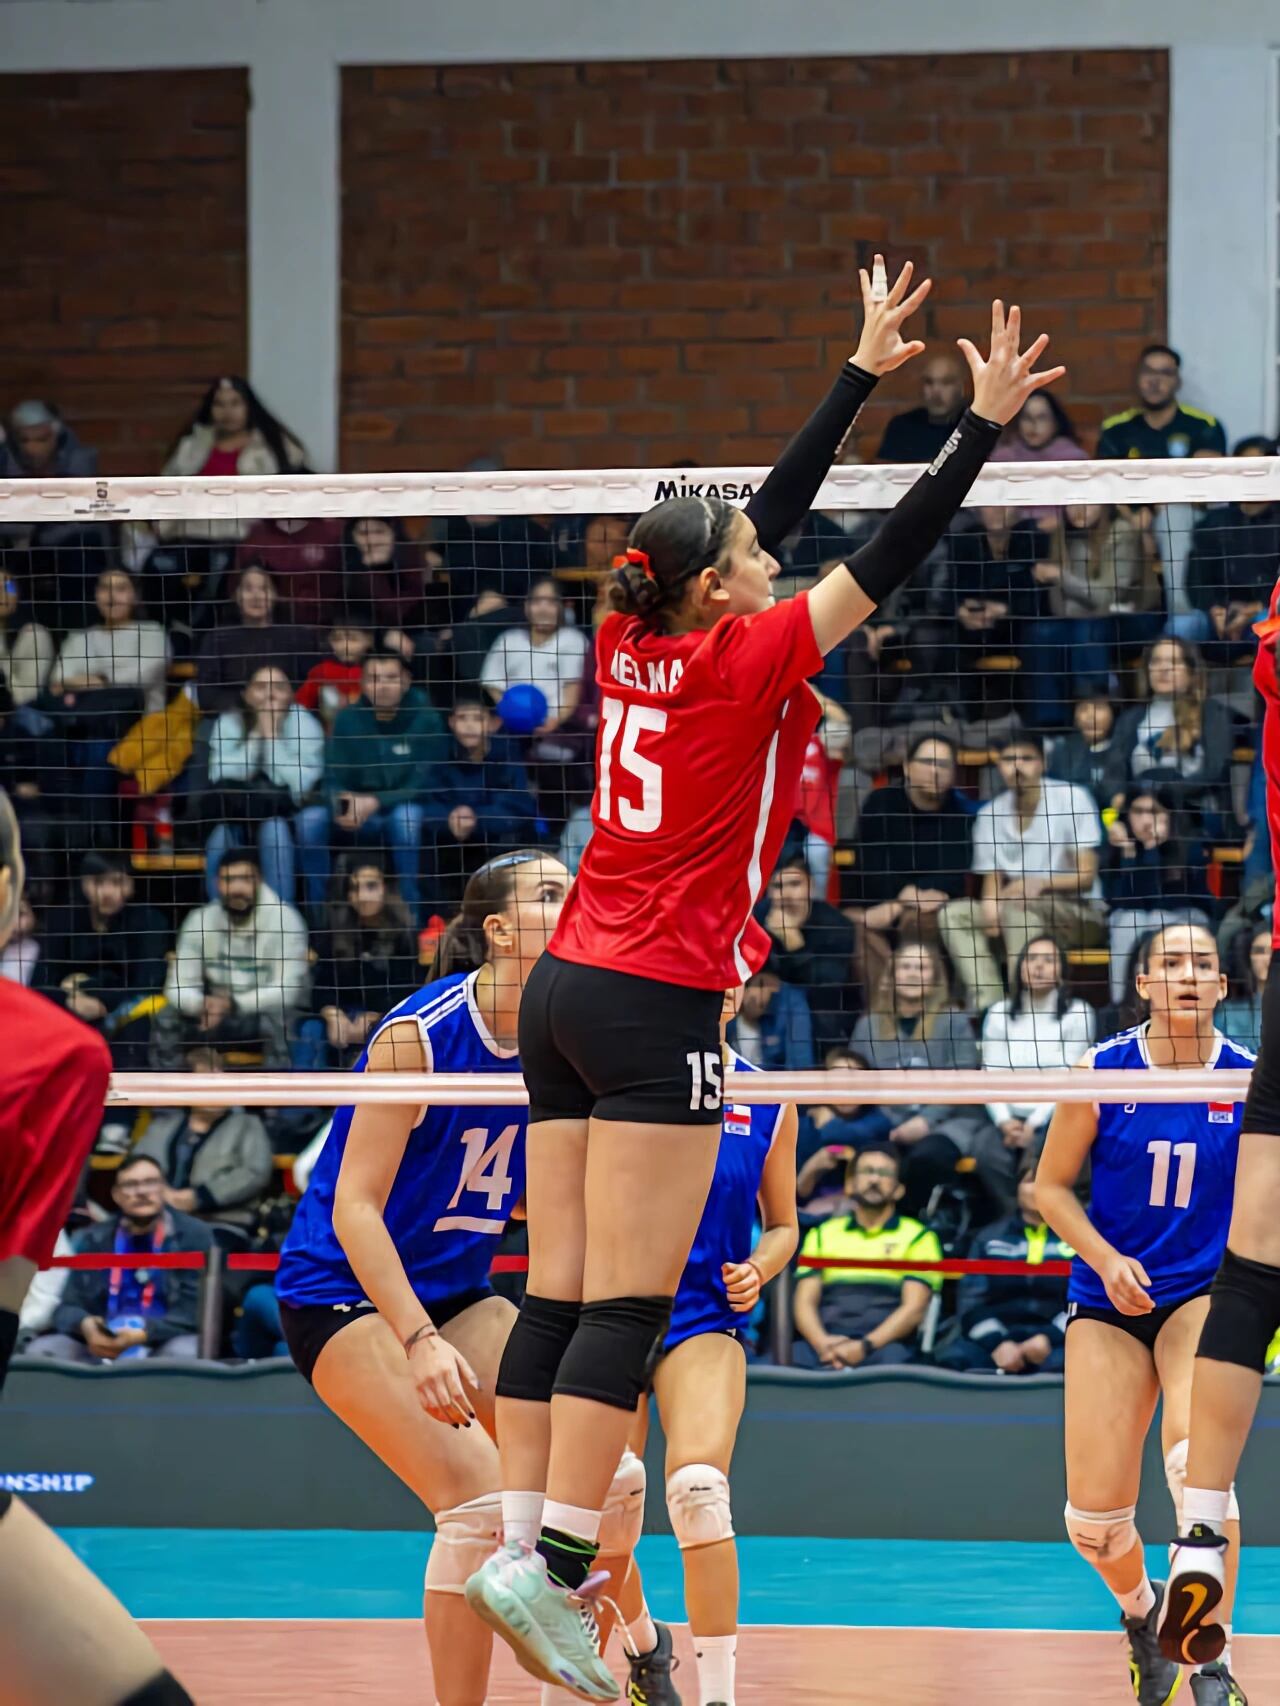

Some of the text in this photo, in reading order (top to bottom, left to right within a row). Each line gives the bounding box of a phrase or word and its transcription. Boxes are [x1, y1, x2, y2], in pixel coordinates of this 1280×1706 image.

[598, 696, 668, 833] 15
[686, 1050, 721, 1110] 15
[446, 1124, 520, 1211] 14
[1146, 1140, 1197, 1209] 11
[0, 1473, 94, 1492] NSHIP
